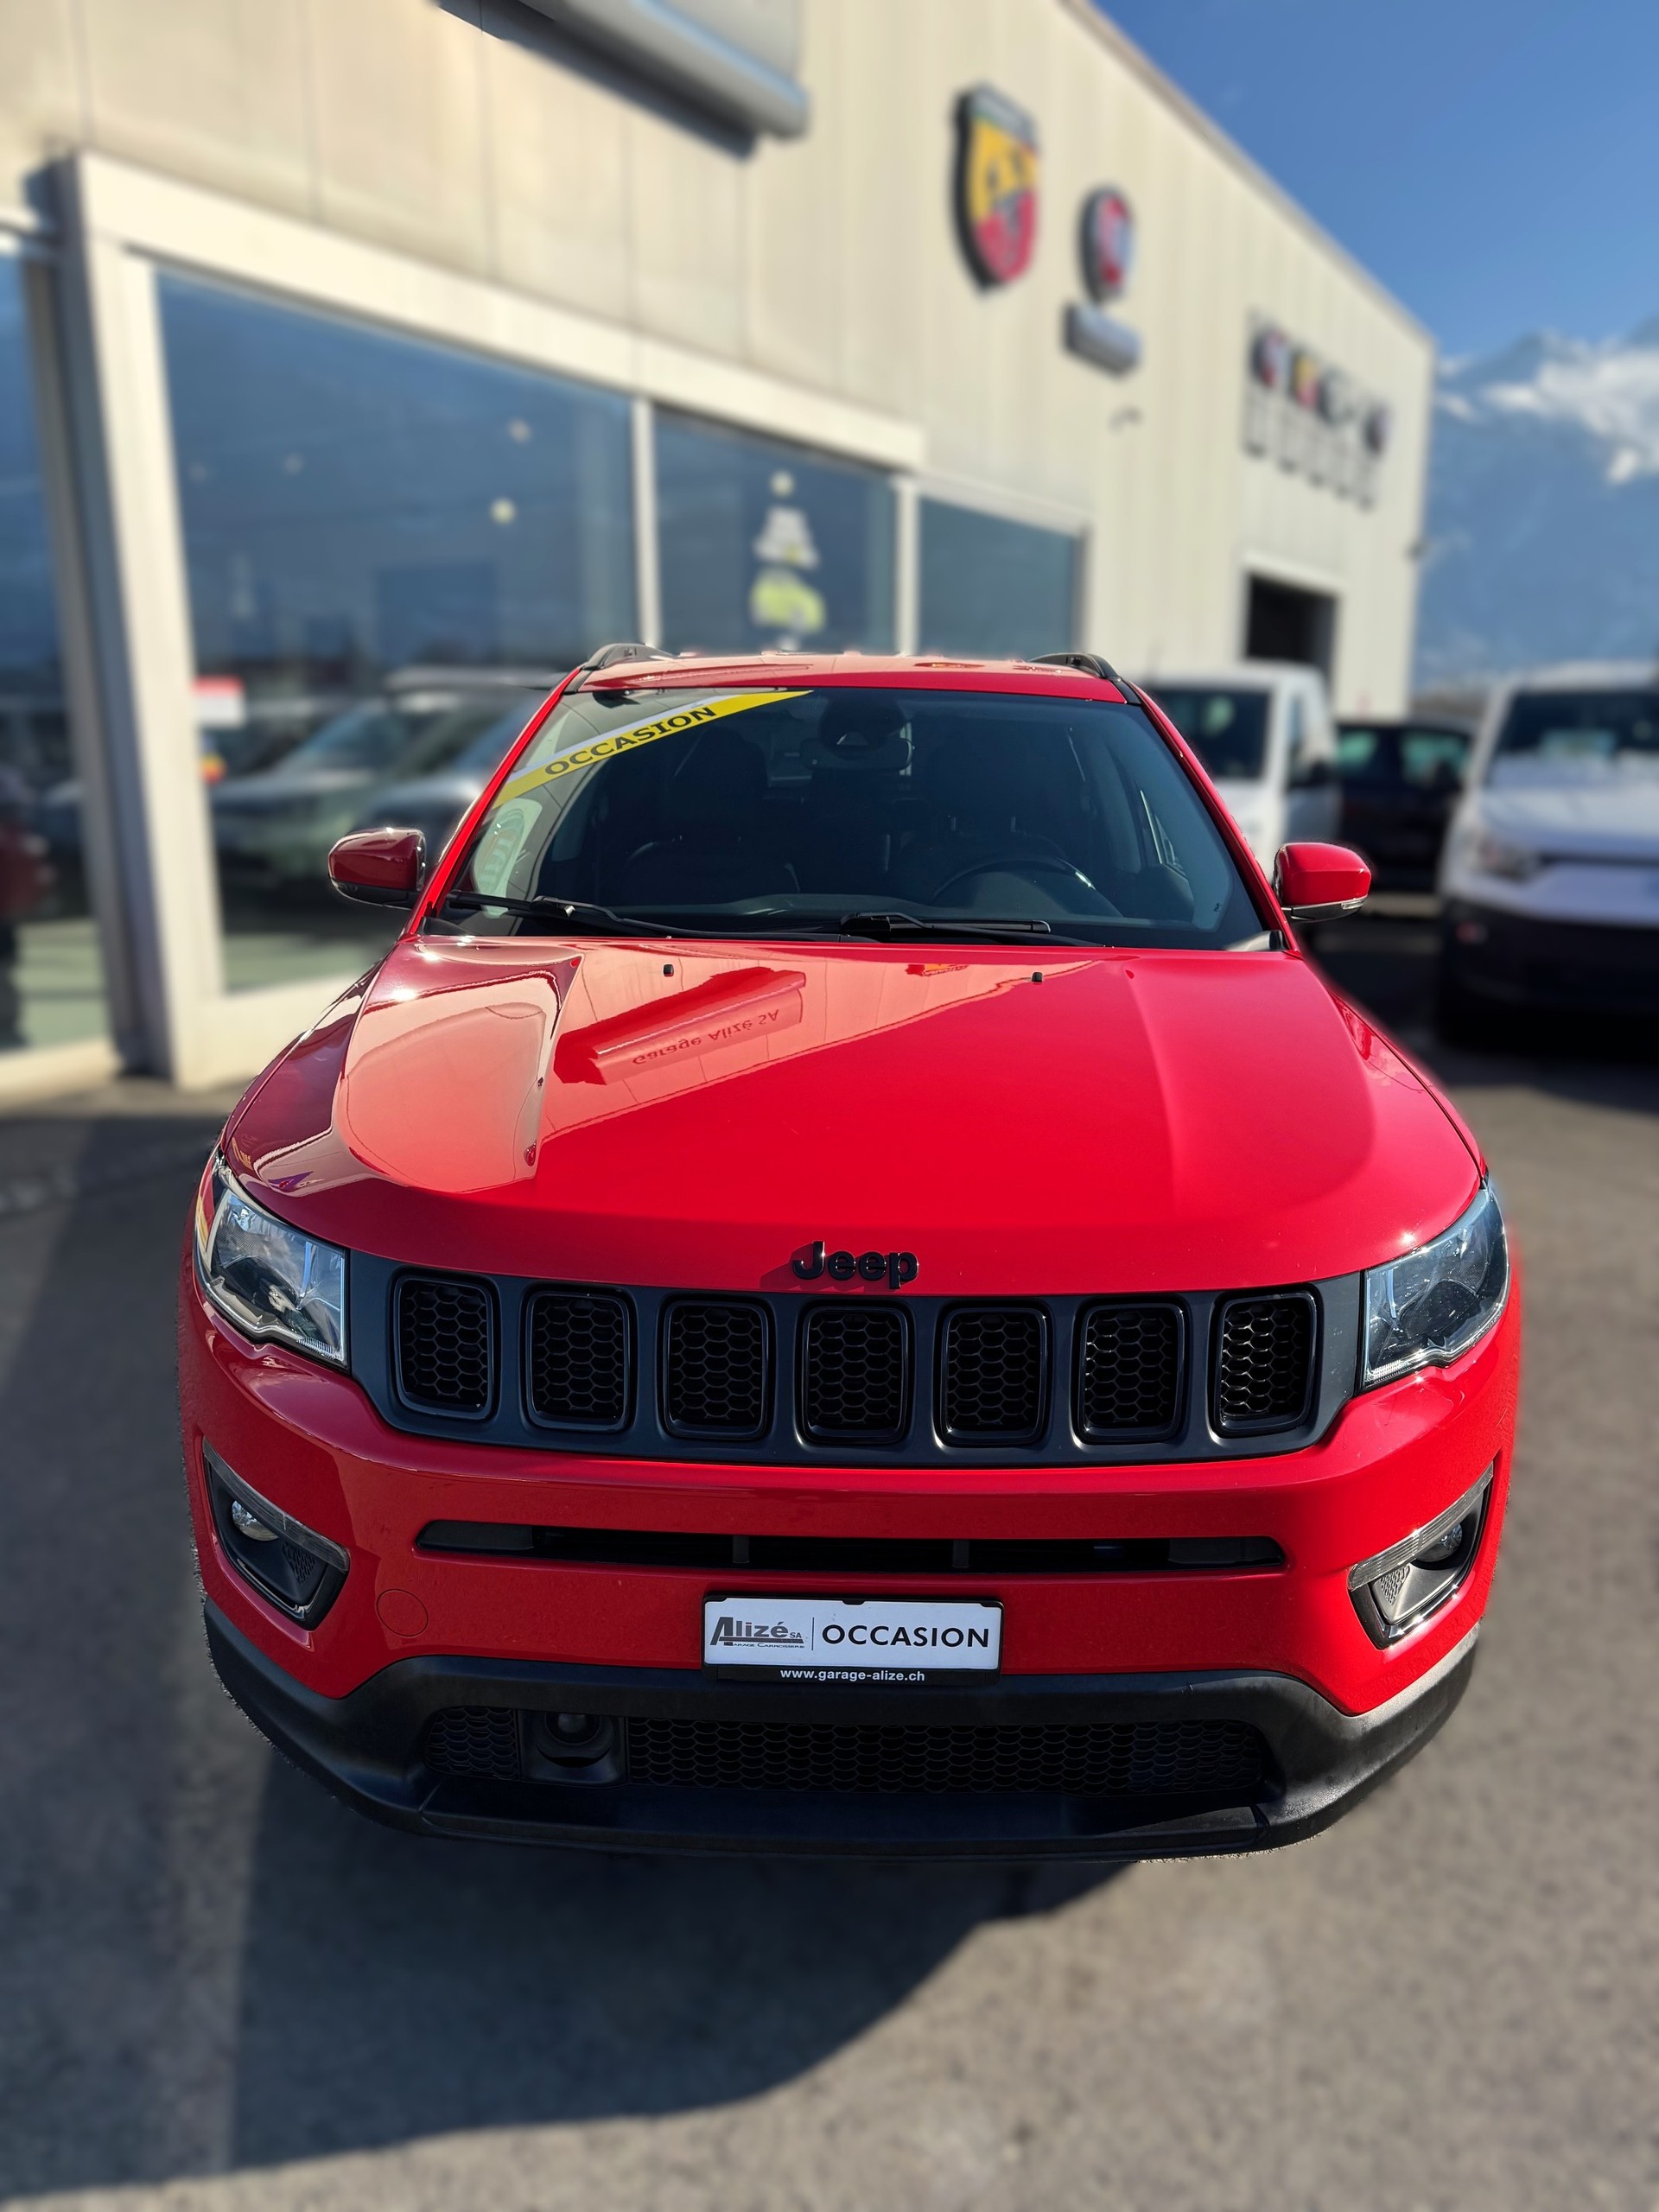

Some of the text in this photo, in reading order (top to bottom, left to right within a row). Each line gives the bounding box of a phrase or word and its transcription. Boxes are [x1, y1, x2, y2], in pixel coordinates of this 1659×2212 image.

[544, 707, 717, 776] OCCASION
[791, 1240, 919, 1290] Jeep
[709, 1616, 788, 1646] Alizé
[822, 1624, 988, 1648] OCCASION
[780, 1669, 925, 1682] www.garage-alize.ch
